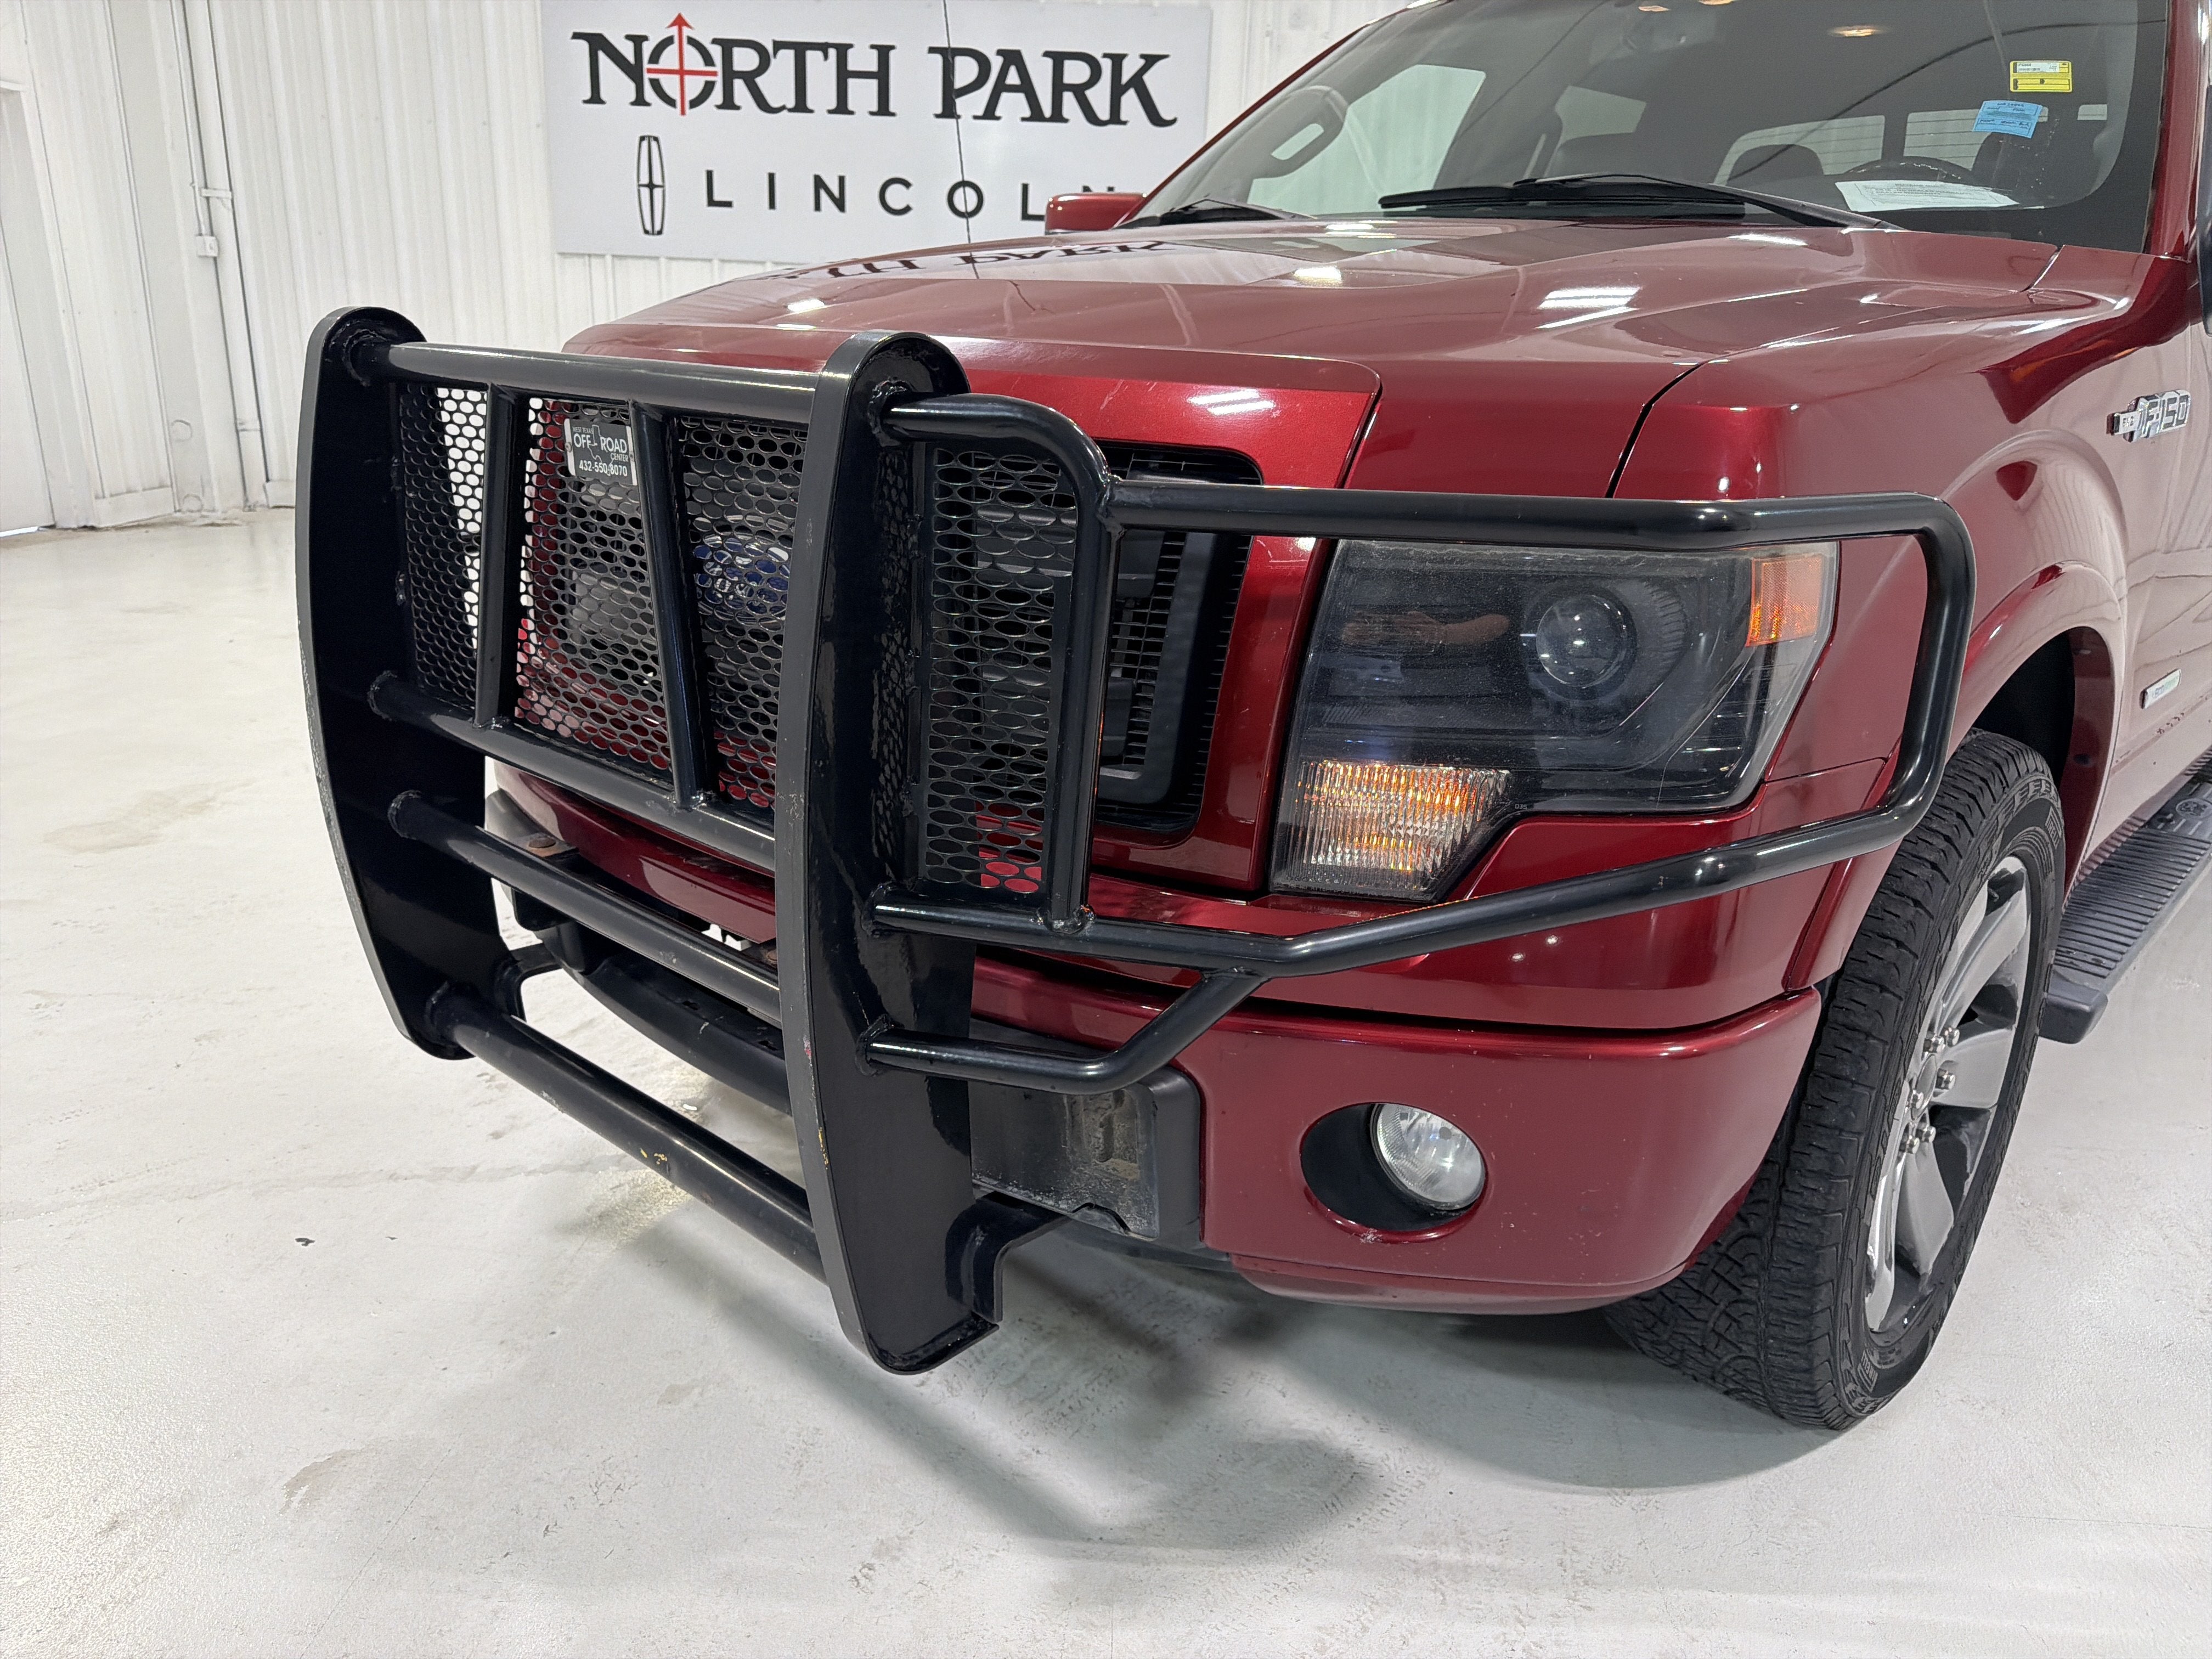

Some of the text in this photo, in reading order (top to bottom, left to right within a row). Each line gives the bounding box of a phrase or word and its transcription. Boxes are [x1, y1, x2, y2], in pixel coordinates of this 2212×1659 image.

[571, 31, 1178, 128] NORTH PARK
[705, 170, 1114, 222] LINCOL
[574, 433, 591, 448] OFF
[600, 436, 628, 454] ROAD
[610, 453, 629, 462] CENTER
[579, 460, 628, 477] 432-550-8070
